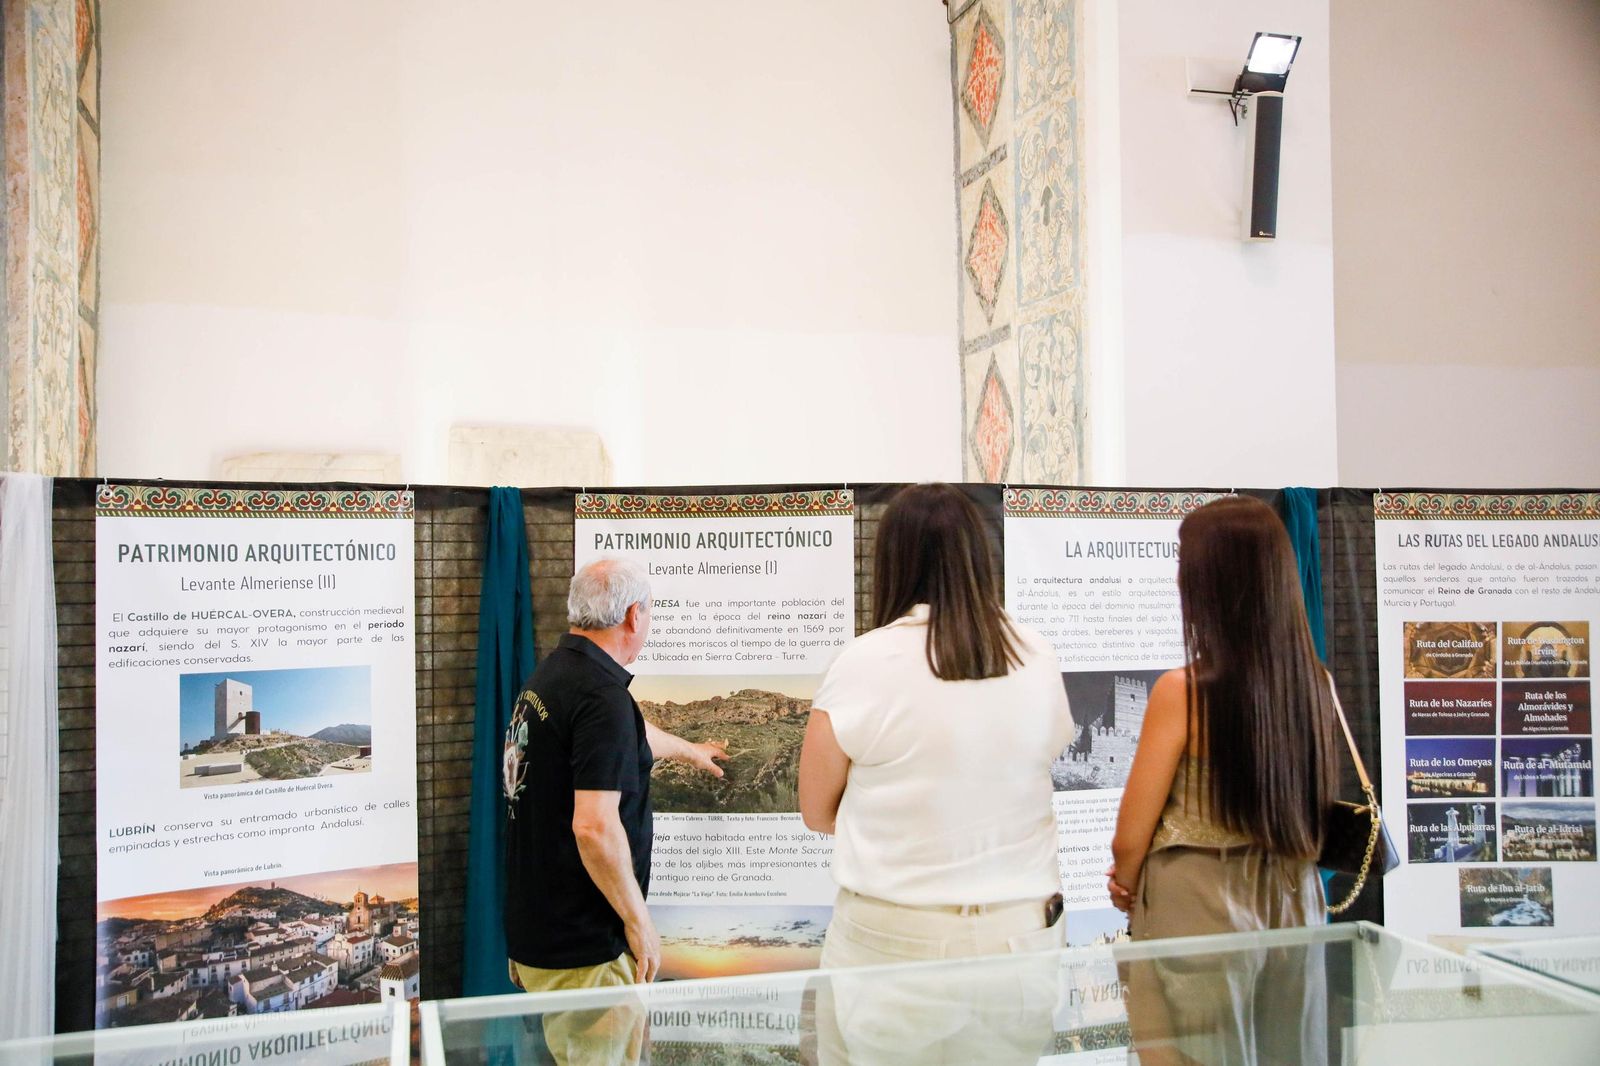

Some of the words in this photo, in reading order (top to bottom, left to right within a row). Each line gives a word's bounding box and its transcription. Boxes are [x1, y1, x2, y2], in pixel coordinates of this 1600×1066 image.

[595, 532, 690, 550] PATRIMONIO
[696, 527, 832, 550] ARQUITECTÓNICO
[1399, 533, 1420, 547] LAS
[1425, 534, 1462, 547] RUTAS
[1467, 534, 1488, 547] DEL
[1493, 534, 1538, 547] LEGADO
[1544, 534, 1599, 547] ANDALUS
[119, 544, 238, 563] PATRIMONIO
[245, 539, 395, 564] ARQUITECTÓNICO
[1066, 541, 1082, 558] LA
[1087, 541, 1180, 560] ARQUITECTUR
[649, 562, 693, 575] Levante
[698, 562, 761, 574] Almeriense
[766, 560, 777, 575] (I)
[182, 577, 235, 591] Levante
[241, 576, 313, 590] Almeriense
[318, 574, 335, 589] (II)
[1017, 576, 1027, 584] La
[1034, 577, 1082, 585] arquitectura
[1438, 587, 1460, 595] Reino
[1464, 587, 1475, 595] de
[1478, 587, 1512, 595] Granada
[728, 599, 776, 608] importante
[782, 598, 825, 608] población
[831, 597, 844, 606] del
[113, 613, 123, 622] El
[128, 612, 168, 621] Castillo
[173, 612, 186, 620] de
[300, 608, 360, 617] construcción
[364, 606, 404, 615] medieval
[699, 613, 706, 621] la
[713, 613, 741, 622] época
[747, 612, 760, 620] del
[768, 612, 790, 620] reino
[798, 611, 826, 619] nazarí
[833, 611, 844, 619] de
[109, 631, 130, 639] que
[138, 627, 188, 638] adquiere
[217, 627, 249, 635] mayor
[258, 623, 327, 634] protagonismo
[353, 621, 361, 629] el
[368, 620, 404, 630] periodo
[666, 625, 711, 635] abandonó
[716, 626, 783, 634] definitivamente
[803, 625, 824, 633] 1569
[159, 641, 194, 651] siendo
[204, 640, 220, 649] del
[231, 639, 240, 648] S.
[251, 638, 268, 647] XIV
[278, 638, 287, 646] la
[297, 639, 328, 647] mayor
[337, 636, 363, 646] parte
[371, 634, 382, 642] de
[730, 639, 738, 647] al
[741, 640, 771, 648] tiempo
[774, 639, 785, 647] de
[800, 640, 830, 648] guerra
[833, 638, 845, 647] de
[1417, 640, 1436, 648] Ruta
[1452, 640, 1483, 648] Califato
[109, 658, 180, 668] edificaciones
[184, 654, 254, 665] conservadas.
[652, 653, 689, 661] Ubicada
[704, 652, 732, 661] Sierra
[735, 652, 773, 662] Cabrera
[782, 652, 807, 660] Turre.
[1525, 692, 1543, 700] Ruta
[1545, 691, 1555, 699] de
[1556, 691, 1566, 699] los
[1410, 699, 1428, 708] Ruta
[1430, 699, 1440, 708] de
[1441, 699, 1454, 708] los
[1456, 699, 1491, 708] Nazaríes
[1568, 703, 1573, 712] y
[1524, 713, 1567, 722] Almohades
[1410, 758, 1429, 767] Ruta
[1431, 758, 1441, 766] de
[1443, 758, 1455, 766] los
[1458, 758, 1492, 768] Omeyas
[1504, 761, 1524, 769] Ruta
[1526, 761, 1536, 769] de
[110, 823, 157, 840] LUBRÍN
[163, 820, 213, 831] conserva
[240, 809, 297, 824] entramado
[365, 802, 376, 811] de
[384, 800, 410, 809] calles
[1430, 824, 1439, 832] de
[1515, 825, 1534, 833] Ruta
[109, 837, 170, 853] empinadas
[182, 830, 235, 845] estrechas
[237, 830, 266, 839] como
[269, 822, 314, 836] impronta
[705, 833, 745, 841] habitada
[776, 833, 787, 841] los
[790, 832, 816, 843] siglos
[686, 846, 699, 855] del
[702, 847, 722, 856] siglo
[746, 846, 765, 855] Este
[769, 847, 798, 855] Monte
[656, 874, 689, 883] antiguo
[731, 873, 773, 881] Granada.
